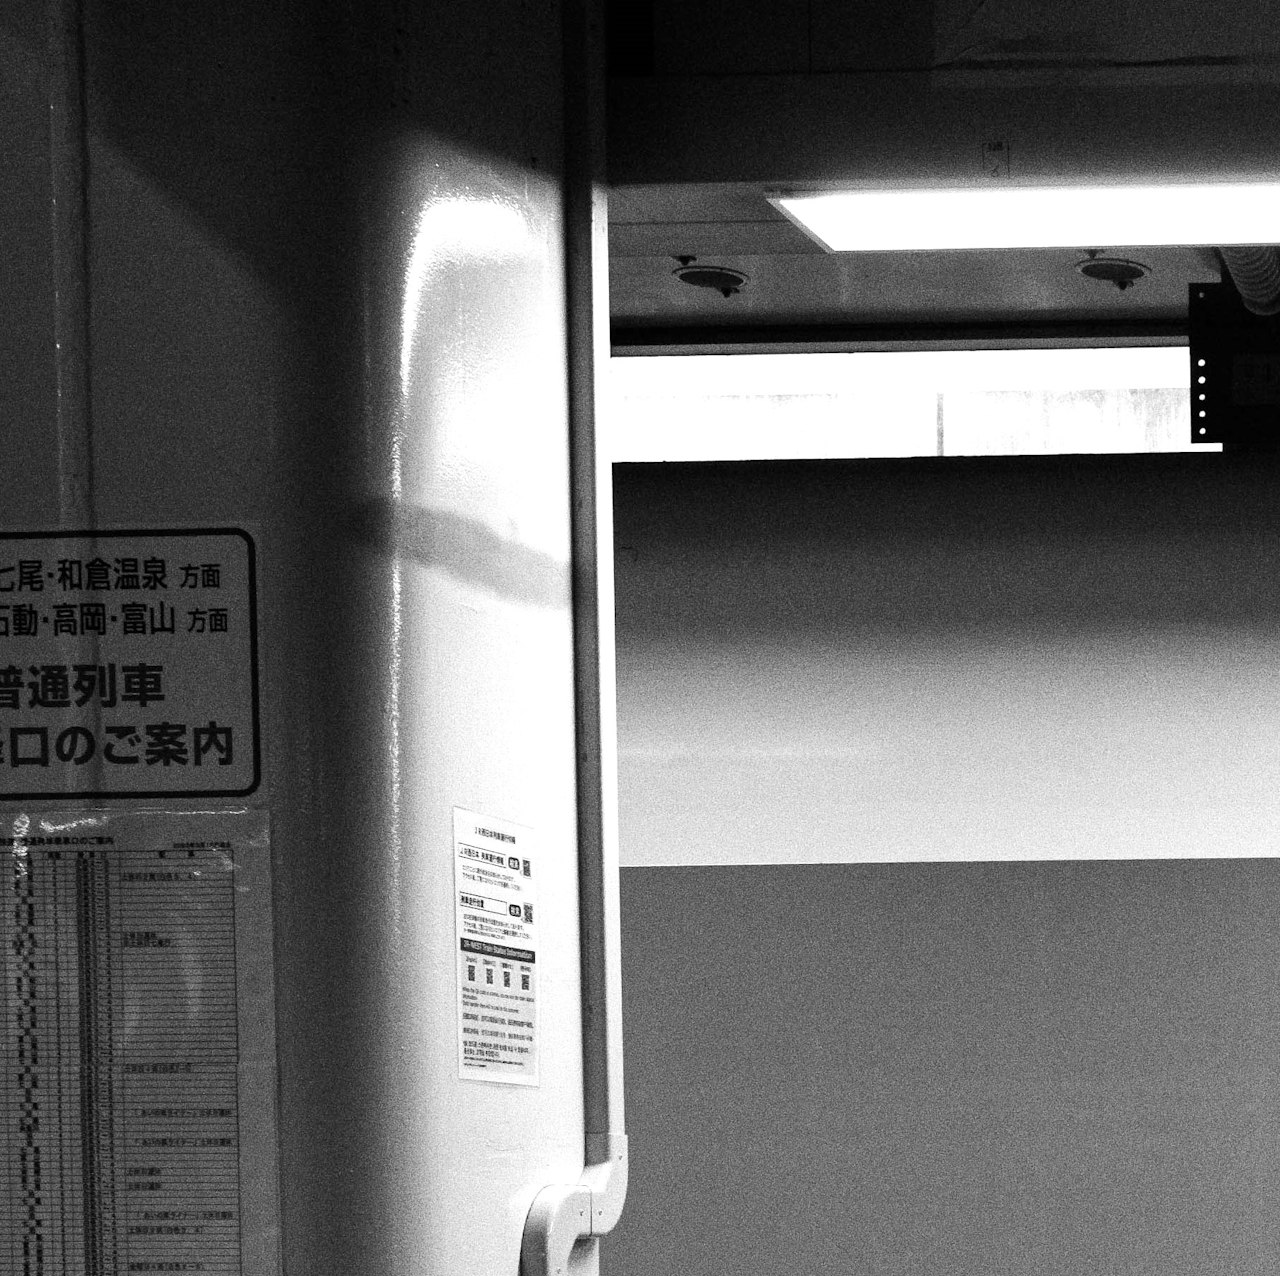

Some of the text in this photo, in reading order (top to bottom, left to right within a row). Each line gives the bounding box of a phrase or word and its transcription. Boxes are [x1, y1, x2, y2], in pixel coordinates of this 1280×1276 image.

[179, 563, 221, 590] 方面
[188, 608, 229, 633] 方面
[0, 721, 234, 768] 口のご案内
